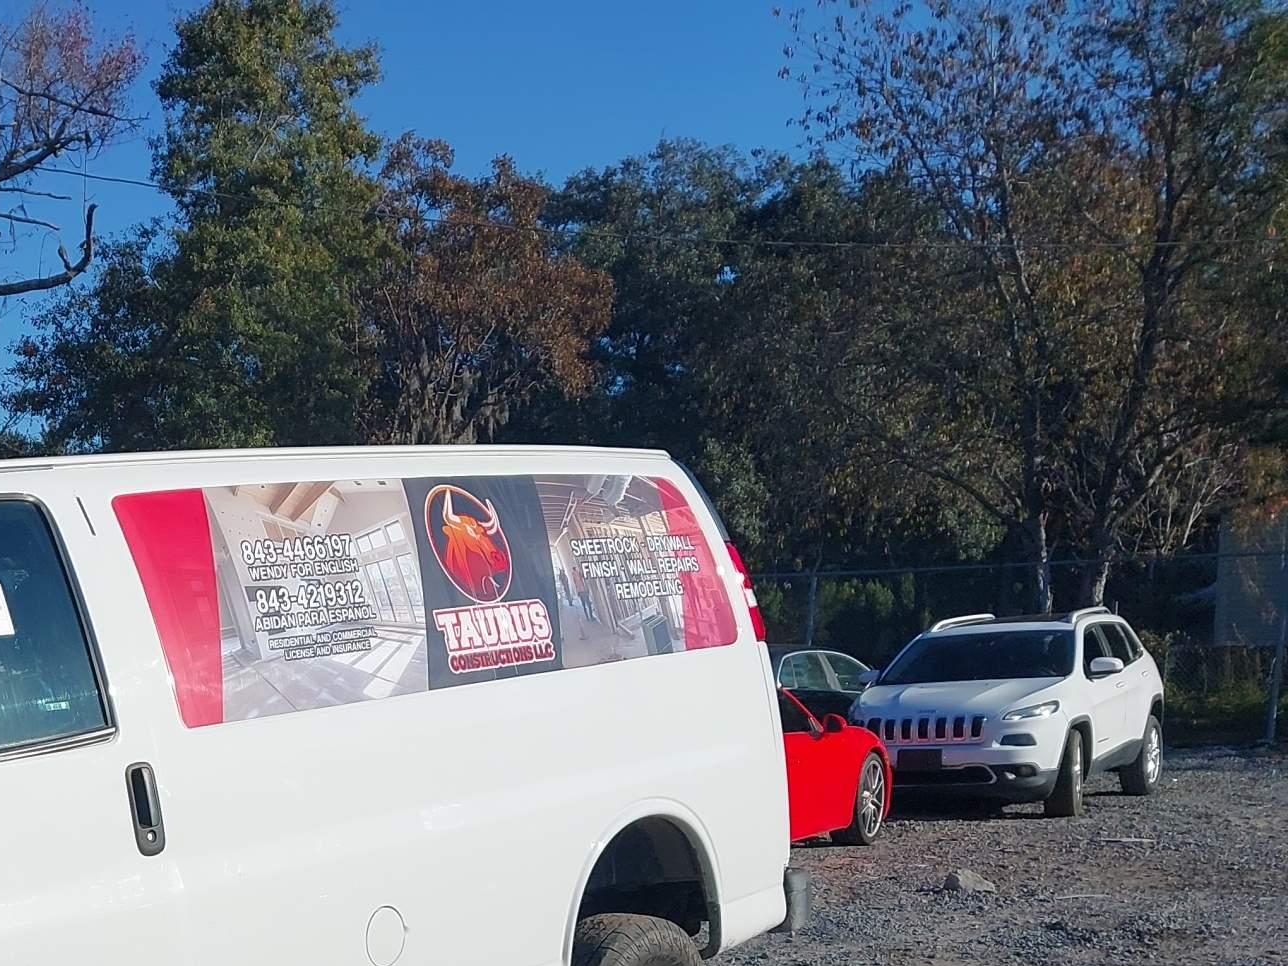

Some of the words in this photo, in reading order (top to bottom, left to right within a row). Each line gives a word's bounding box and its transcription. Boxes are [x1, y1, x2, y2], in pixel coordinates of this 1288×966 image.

[241, 534, 352, 565] 843-4466197
[570, 536, 640, 557] SHEETROCK
[646, 534, 696, 552] DRYWALL
[248, 564, 289, 581] WENDY
[289, 562, 314, 577] FOR
[313, 558, 360, 576] ENGLISH
[581, 560, 620, 580] FINISH
[626, 559, 658, 576] WALL
[658, 556, 701, 573] REPAIRS
[255, 579, 366, 614] 843-4219312
[615, 578, 685, 600] REMODELING
[255, 612, 296, 632] ABIDAN
[297, 609, 328, 627] PARA
[435, 601, 551, 652] TAURUS
[268, 634, 316, 650] RESIDENTIAL
[316, 632, 331, 643] AND
[332, 627, 378, 642] COMMERCIAL
[284, 646, 316, 661] LICENSE
[316, 644, 331, 657] AND
[332, 639, 372, 654] INSURANCE
[450, 645, 533, 671] CONSTRUCTIONS
[533, 642, 554, 660] LLC
